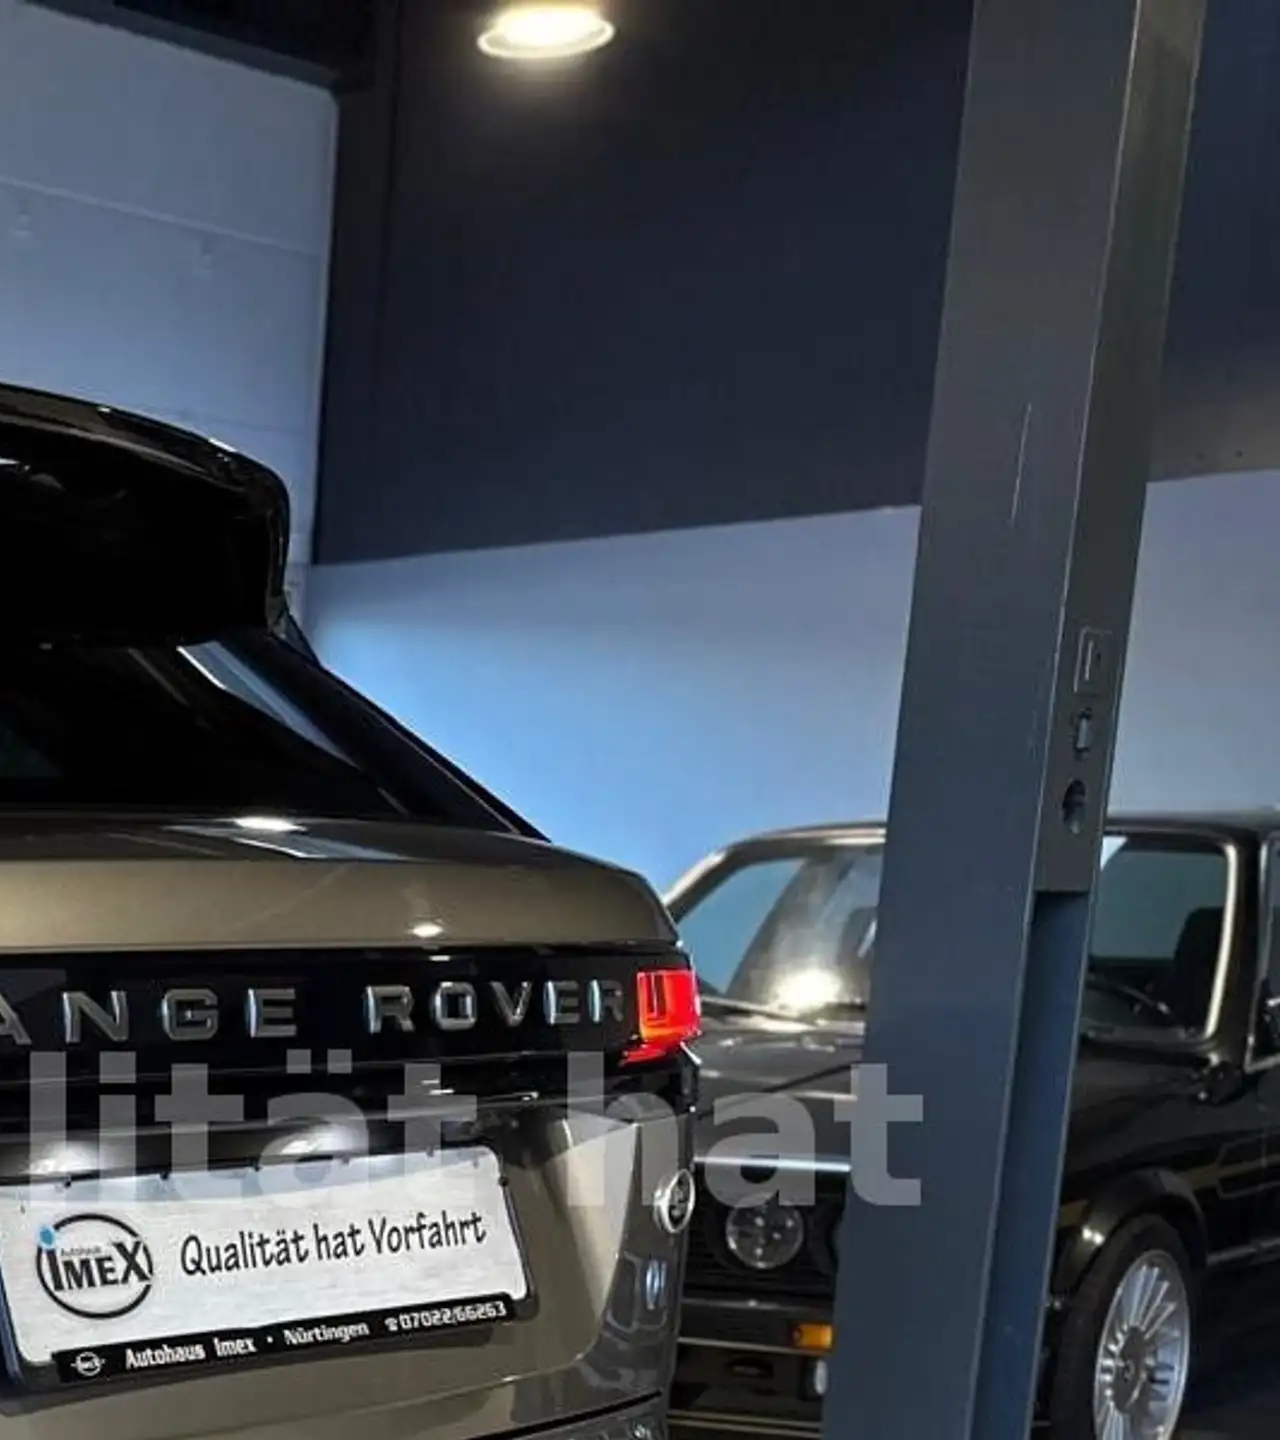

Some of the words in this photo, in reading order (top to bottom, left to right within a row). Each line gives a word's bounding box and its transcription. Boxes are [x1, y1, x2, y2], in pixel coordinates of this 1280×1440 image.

[365, 979, 625, 1036] ROVER
[180, 1229, 309, 1277] Qualität
[313, 1223, 365, 1262] hat
[368, 1210, 487, 1255] Vorfahrt
[125, 1342, 206, 1370] Autohaus
[212, 1337, 257, 1358] Imex
[284, 1319, 370, 1346] Nürtingen
